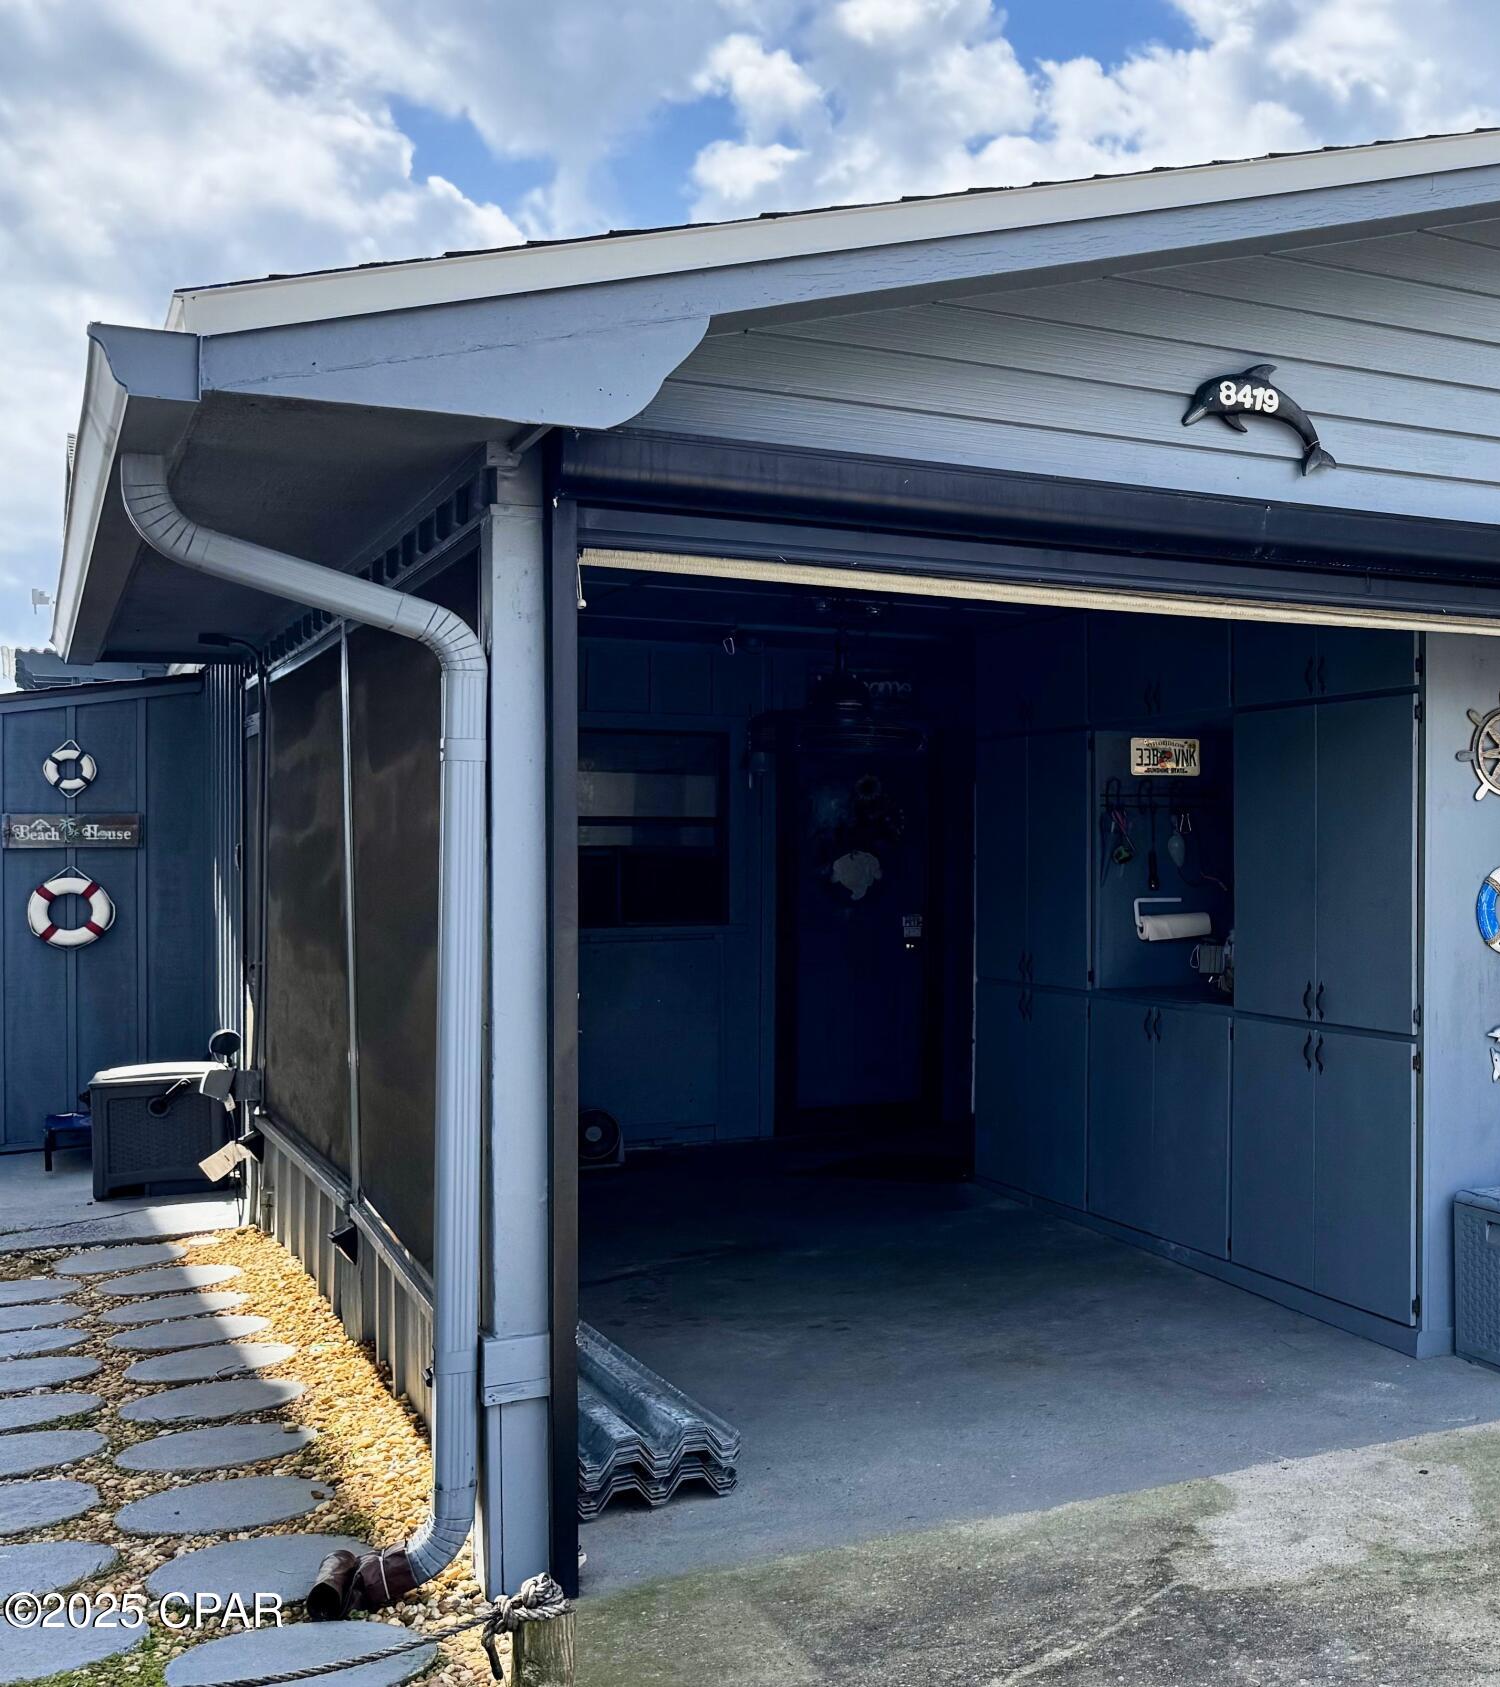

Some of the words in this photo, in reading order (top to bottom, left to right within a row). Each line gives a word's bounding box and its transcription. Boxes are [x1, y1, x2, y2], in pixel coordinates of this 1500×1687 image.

[1219, 380, 1280, 413] 8419
[1135, 747, 1159, 767] 33B
[1173, 748, 1197, 767] VNK
[12, 823, 60, 841] Beach
[81, 824, 132, 840] House
